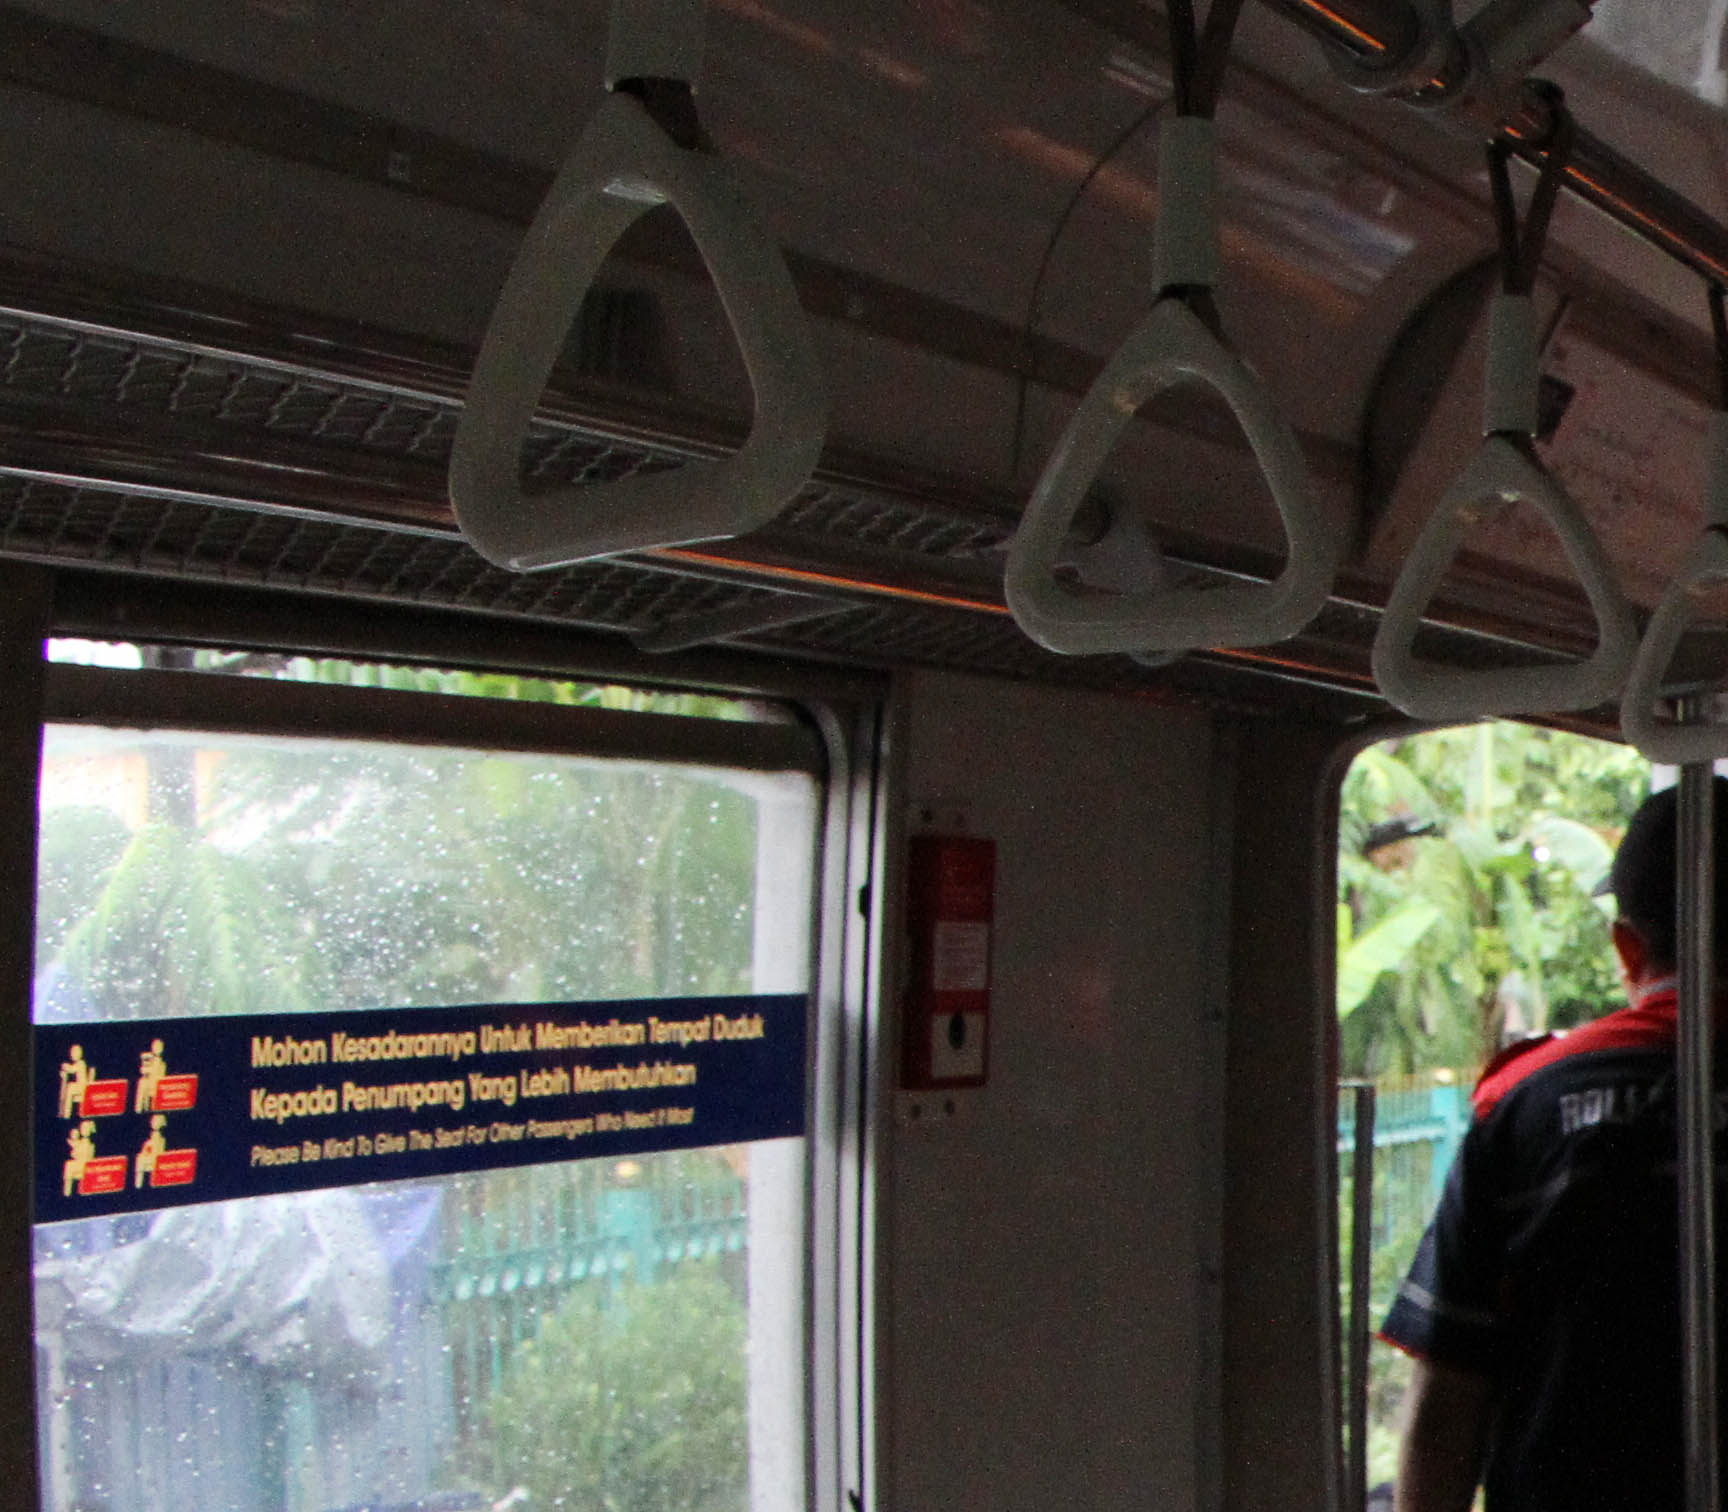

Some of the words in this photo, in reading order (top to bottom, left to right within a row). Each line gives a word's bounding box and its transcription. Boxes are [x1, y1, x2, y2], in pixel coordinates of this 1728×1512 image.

[251, 1036, 327, 1068] Mohon
[331, 1029, 477, 1062] Kesadarannya
[480, 1023, 532, 1054] Untuk
[535, 1018, 645, 1050] Memberikan
[648, 1014, 711, 1048] Tempat
[712, 1013, 764, 1041] Duduk
[251, 1086, 338, 1125] Kepada
[342, 1080, 466, 1113] Penumpang
[468, 1072, 517, 1106] Yang
[520, 1067, 570, 1098] Lebih
[573, 1060, 697, 1095] Membutuhkan
[251, 1145, 300, 1167] Please
[302, 1140, 321, 1162] Be
[323, 1137, 355, 1159] Kind
[356, 1135, 373, 1156] To
[374, 1132, 407, 1155] Give
